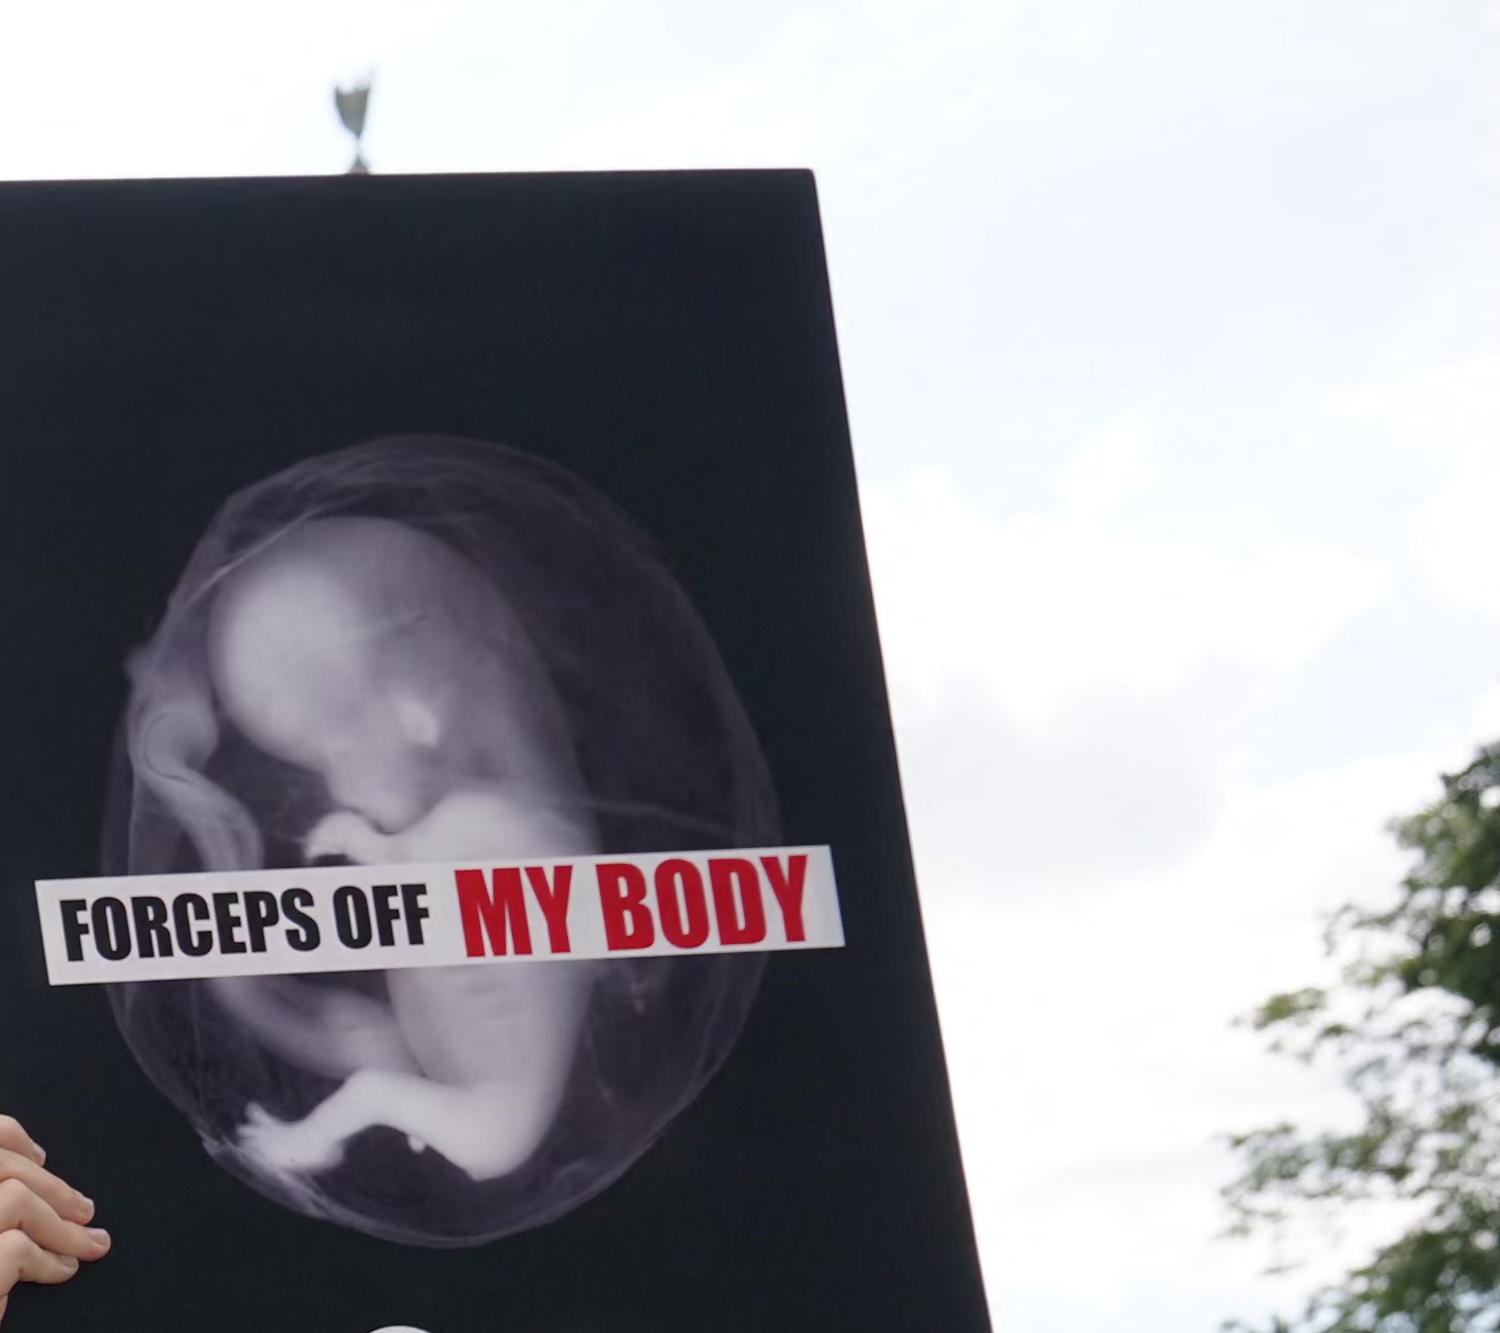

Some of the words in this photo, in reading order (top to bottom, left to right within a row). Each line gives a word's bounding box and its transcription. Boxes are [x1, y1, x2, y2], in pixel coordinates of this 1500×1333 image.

[59, 888, 321, 963] FORCEPS
[332, 884, 430, 950] OFF
[454, 864, 574, 958] MY
[595, 854, 809, 952] BODY
